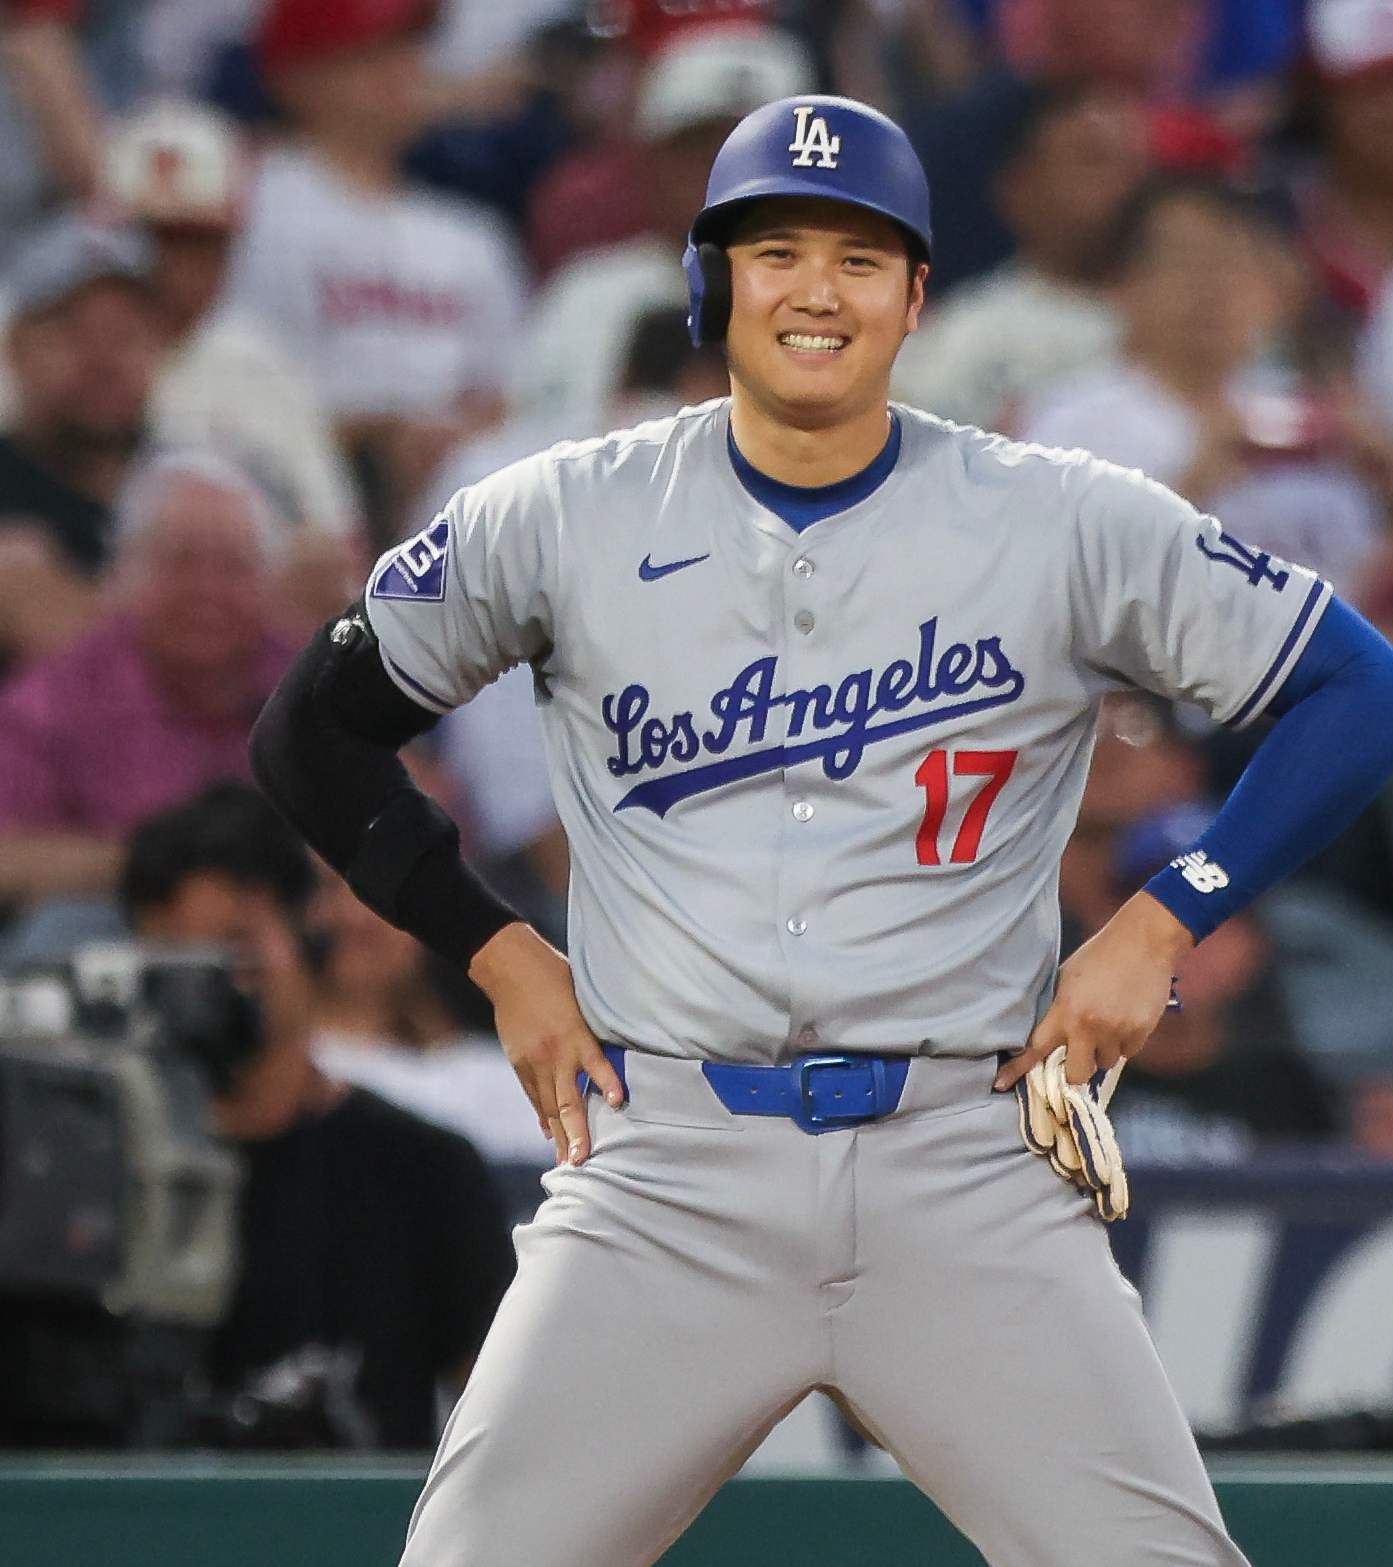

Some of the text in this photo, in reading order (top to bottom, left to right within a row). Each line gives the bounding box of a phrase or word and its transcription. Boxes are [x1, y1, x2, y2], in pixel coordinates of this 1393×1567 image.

[788, 106, 840, 169] LA
[602, 616, 1024, 781] Los Angeles
[914, 750, 1018, 865] 17
